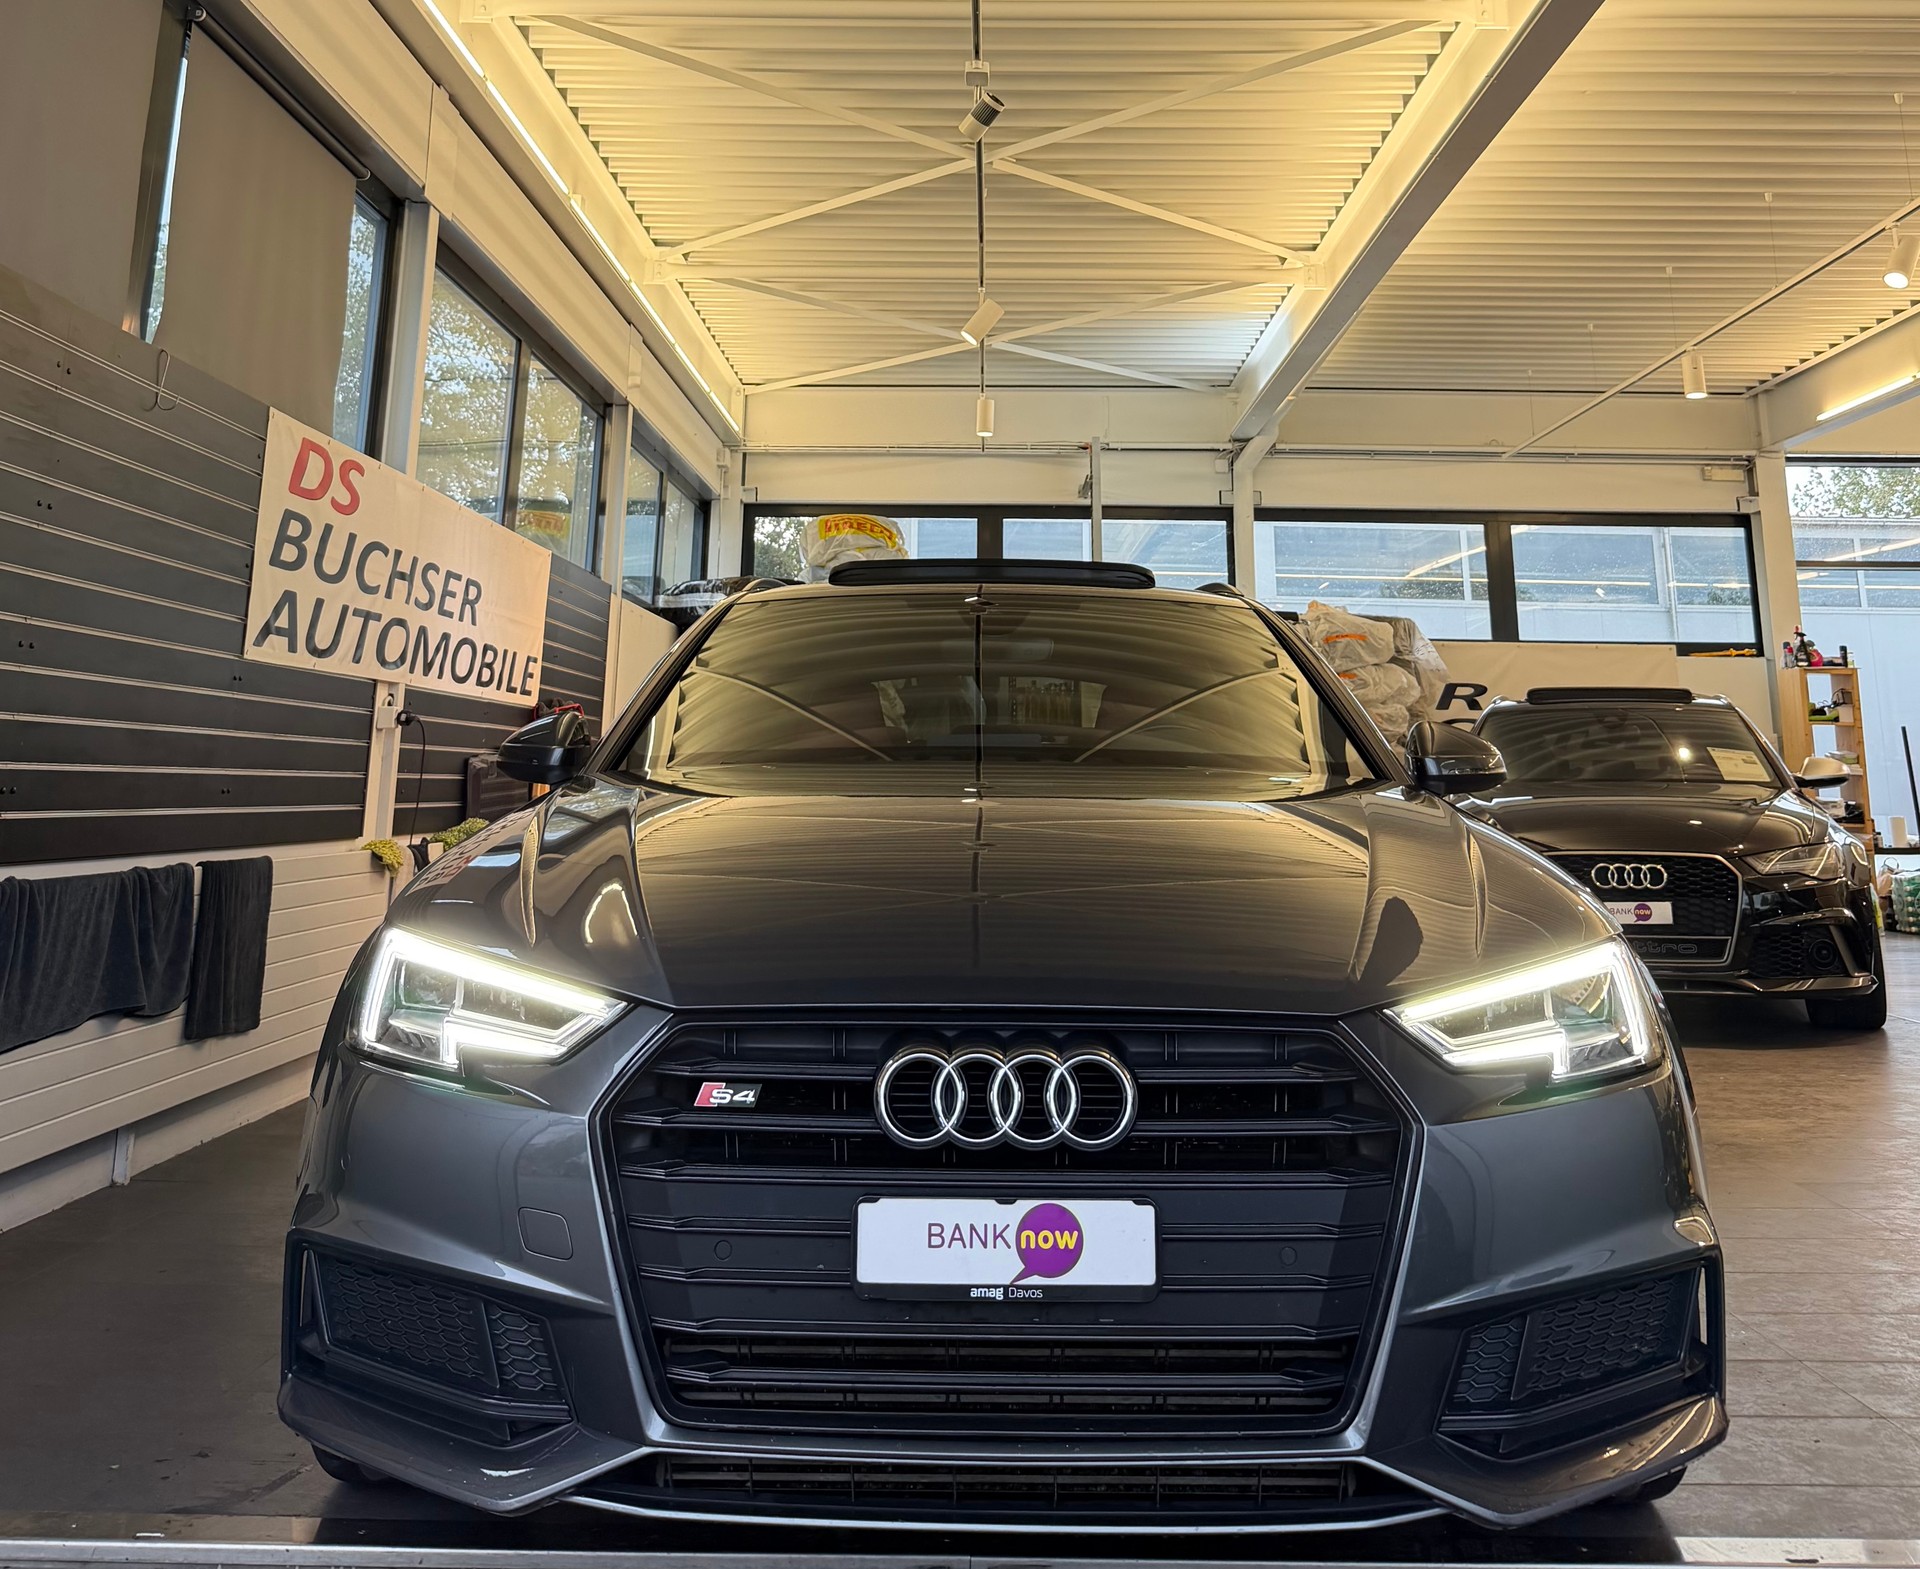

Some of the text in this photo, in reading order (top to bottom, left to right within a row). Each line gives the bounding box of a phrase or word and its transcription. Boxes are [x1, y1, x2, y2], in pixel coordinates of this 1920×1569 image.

[288, 436, 366, 516] DS
[268, 507, 483, 627] BUCHSER
[252, 589, 539, 697] AUTOMOBILE
[1610, 907, 1633, 915] BANK
[709, 1088, 756, 1104] S4
[927, 1222, 1079, 1250] BANK now
[969, 1286, 1044, 1300] amag Davos
